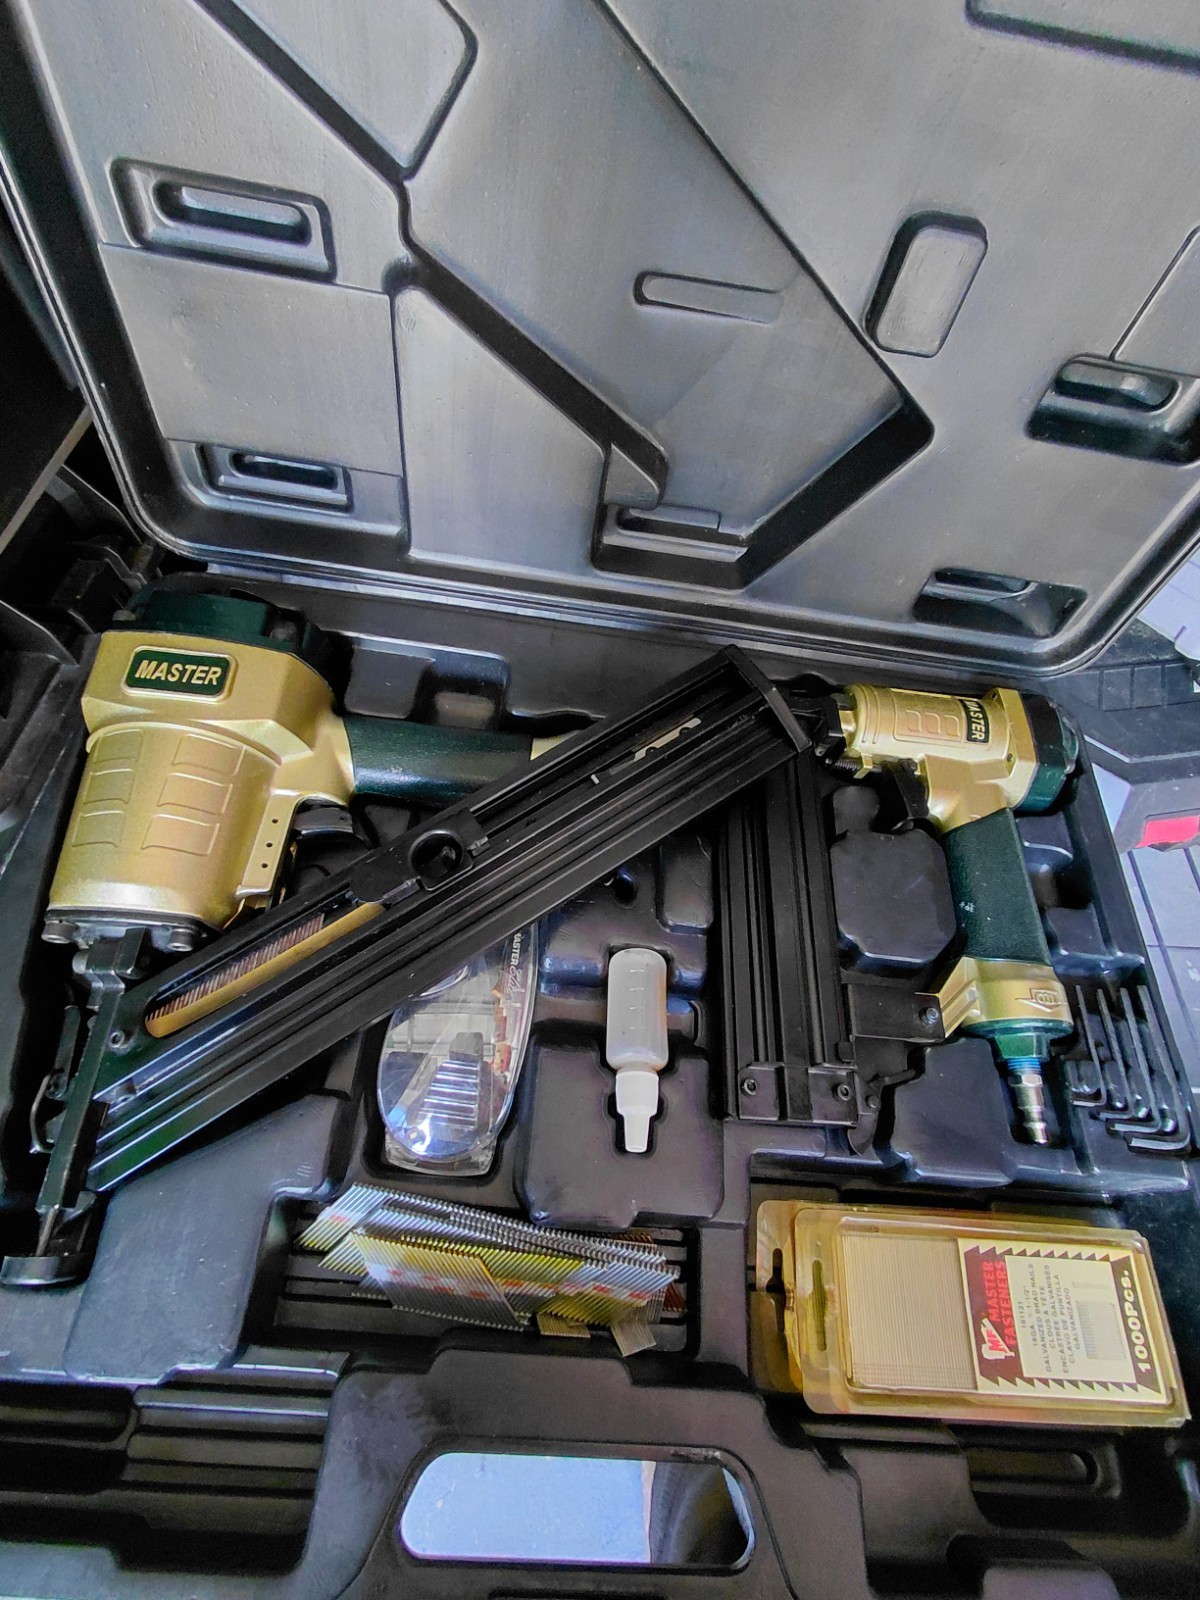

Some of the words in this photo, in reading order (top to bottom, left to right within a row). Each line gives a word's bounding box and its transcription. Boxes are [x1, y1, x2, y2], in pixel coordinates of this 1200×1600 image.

[134, 659, 222, 685] MASTER
[964, 700, 986, 740] MASTER
[982, 1261, 1001, 1322] MASTER
[1028, 1263, 1036, 1288] NAILS
[994, 1261, 1017, 1345] FASTENERS
[1032, 1290, 1041, 1314] BRAD
[1054, 1274, 1065, 1316] PUNTILLA
[1045, 1319, 1055, 1349] CLOUS
[1061, 1319, 1068, 1331] DE
[1064, 1288, 1081, 1350] GALVANIZADO
[1121, 1270, 1151, 1373] 1000Pcs.
[989, 1327, 1003, 1353] MF
[1036, 1316, 1051, 1372] GALVANIZED
[1065, 1333, 1075, 1364] CLAVO
